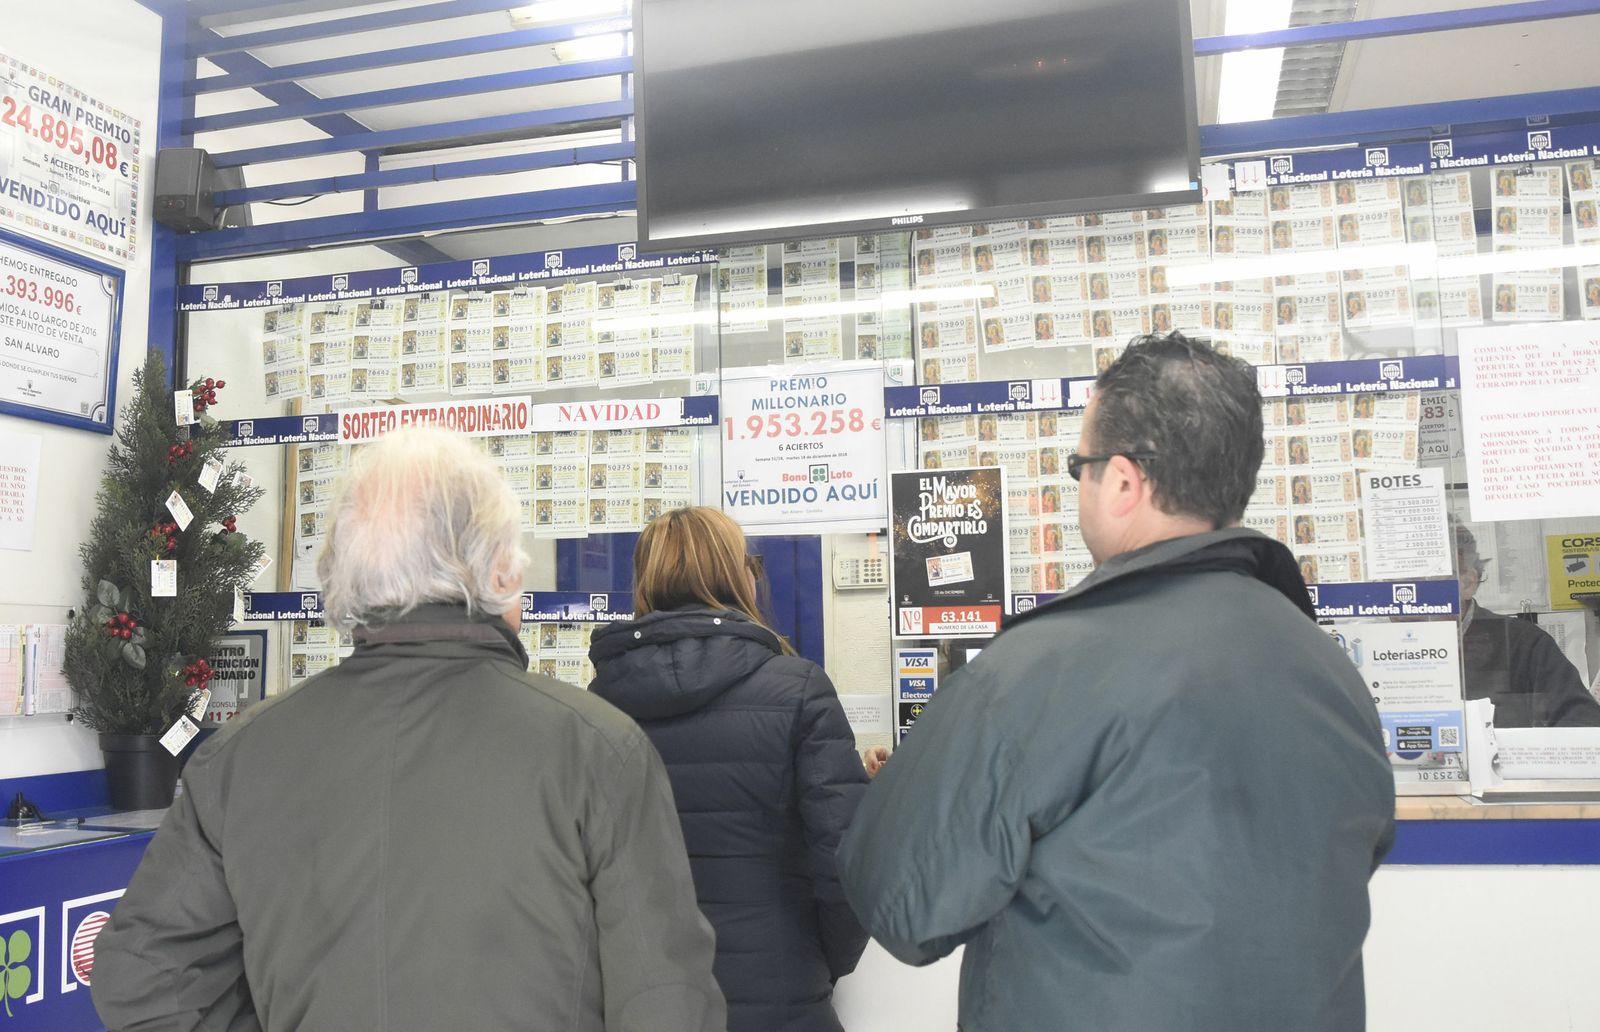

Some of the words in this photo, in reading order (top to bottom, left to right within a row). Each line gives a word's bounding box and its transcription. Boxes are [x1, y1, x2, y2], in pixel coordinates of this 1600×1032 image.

[28, 85, 71, 117] GRAN
[75, 107, 131, 144] PREMIO
[43, 154, 49, 162] 5
[50, 156, 90, 178] ACIERTOS
[1439, 155, 1489, 168] Nacional
[1494, 151, 1536, 164] Lotería
[1537, 145, 1588, 160] Nacional
[1279, 170, 1328, 184] Nacional
[1332, 168, 1373, 180] Lotería
[1375, 164, 1424, 177] Nacional
[0, 176, 81, 221] VENDIDO
[85, 210, 126, 239] AQUÍ
[892, 215, 924, 226] PHILIPS
[29, 264, 78, 288] ENTREGADO
[181, 301, 207, 311] Lotería
[208, 299, 240, 310] Nacional
[243, 298, 271, 307] Lotería
[272, 294, 306, 305] Nacional
[308, 292, 337, 302] Lotería
[338, 288, 372, 299] Nacional
[376, 283, 406, 295] Lotería
[407, 281, 443, 292] Nacional
[447, 275, 478, 287] Lotería
[479, 272, 516, 284] Nacional
[518, 269, 551, 281] Lotería
[552, 264, 590, 277] Nacional
[591, 261, 624, 273] Lotería
[625, 257, 664, 270] Nacional
[667, 254, 700, 266] Lotería
[16, 318, 45, 334] PUNTO
[46, 327, 57, 338] DE
[58, 330, 84, 345] VENTA
[21, 309, 28, 318] A
[28, 311, 40, 321] LO
[41, 314, 68, 329] LARGO
[70, 321, 80, 332] DE
[81, 325, 97, 337] 2016
[4, 336, 23, 349] SAN
[25, 342, 60, 359] ALVARO
[770, 376, 828, 392] PREMIO
[1293, 383, 1342, 395] Nacional
[1346, 380, 1387, 392] Lotería
[1390, 377, 1439, 391] Nacional
[751, 392, 847, 411] MILLONARIO
[890, 404, 926, 417] Lotería
[928, 403, 972, 415] Nacional
[558, 403, 661, 423] NAVIDAD
[343, 410, 397, 440] SORTEO
[724, 407, 865, 441] 1.953.258
[870, 417, 882, 431] €
[244, 435, 277, 445] Nacional
[778, 443, 784, 451] 6
[785, 442, 824, 451] ACIERTOS
[782, 473, 808, 482] Bono
[830, 469, 853, 480] Loto
[1370, 473, 1422, 490] BOTES
[726, 487, 818, 507] VENDIDO
[826, 478, 878, 502] AQUÍ
[919, 477, 933, 491] EL
[933, 475, 977, 505] MAYOR
[919, 492, 964, 521] PREMIO
[907, 515, 988, 549] COMPARTIRLO
[278, 609, 306, 620] Lotería
[522, 610, 560, 620] Nacional
[940, 610, 982, 622] 63.141
[1358, 604, 1400, 615] Lotería
[1402, 602, 1452, 614] Nacional
[905, 657, 929, 667] VISA
[908, 679, 926, 687] VISA
